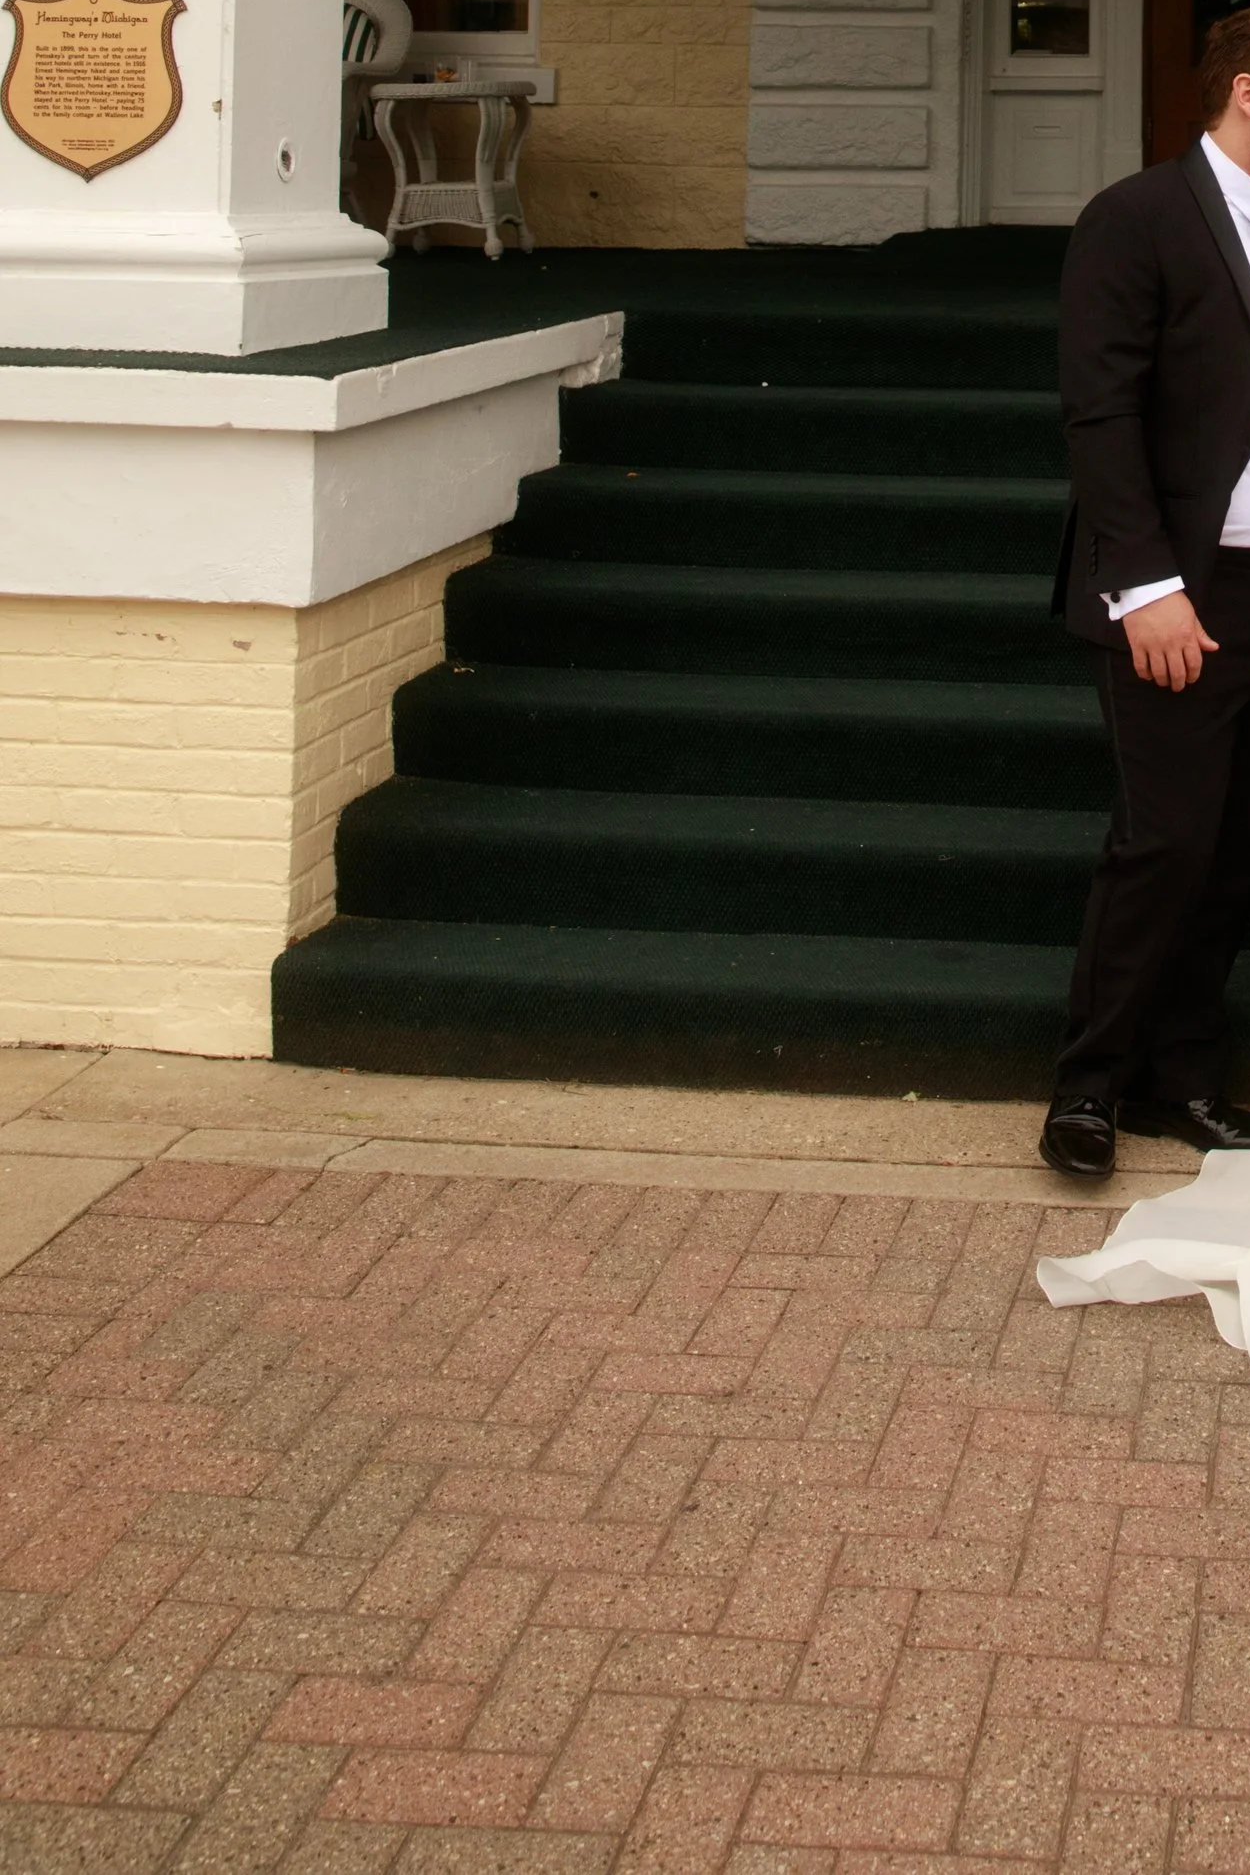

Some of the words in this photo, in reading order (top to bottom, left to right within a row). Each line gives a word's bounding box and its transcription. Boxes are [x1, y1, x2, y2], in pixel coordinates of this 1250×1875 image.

[35, 11, 98, 26] Hemingway's
[101, 12, 148, 26] Michigan
[79, 32, 98, 40] Perry
